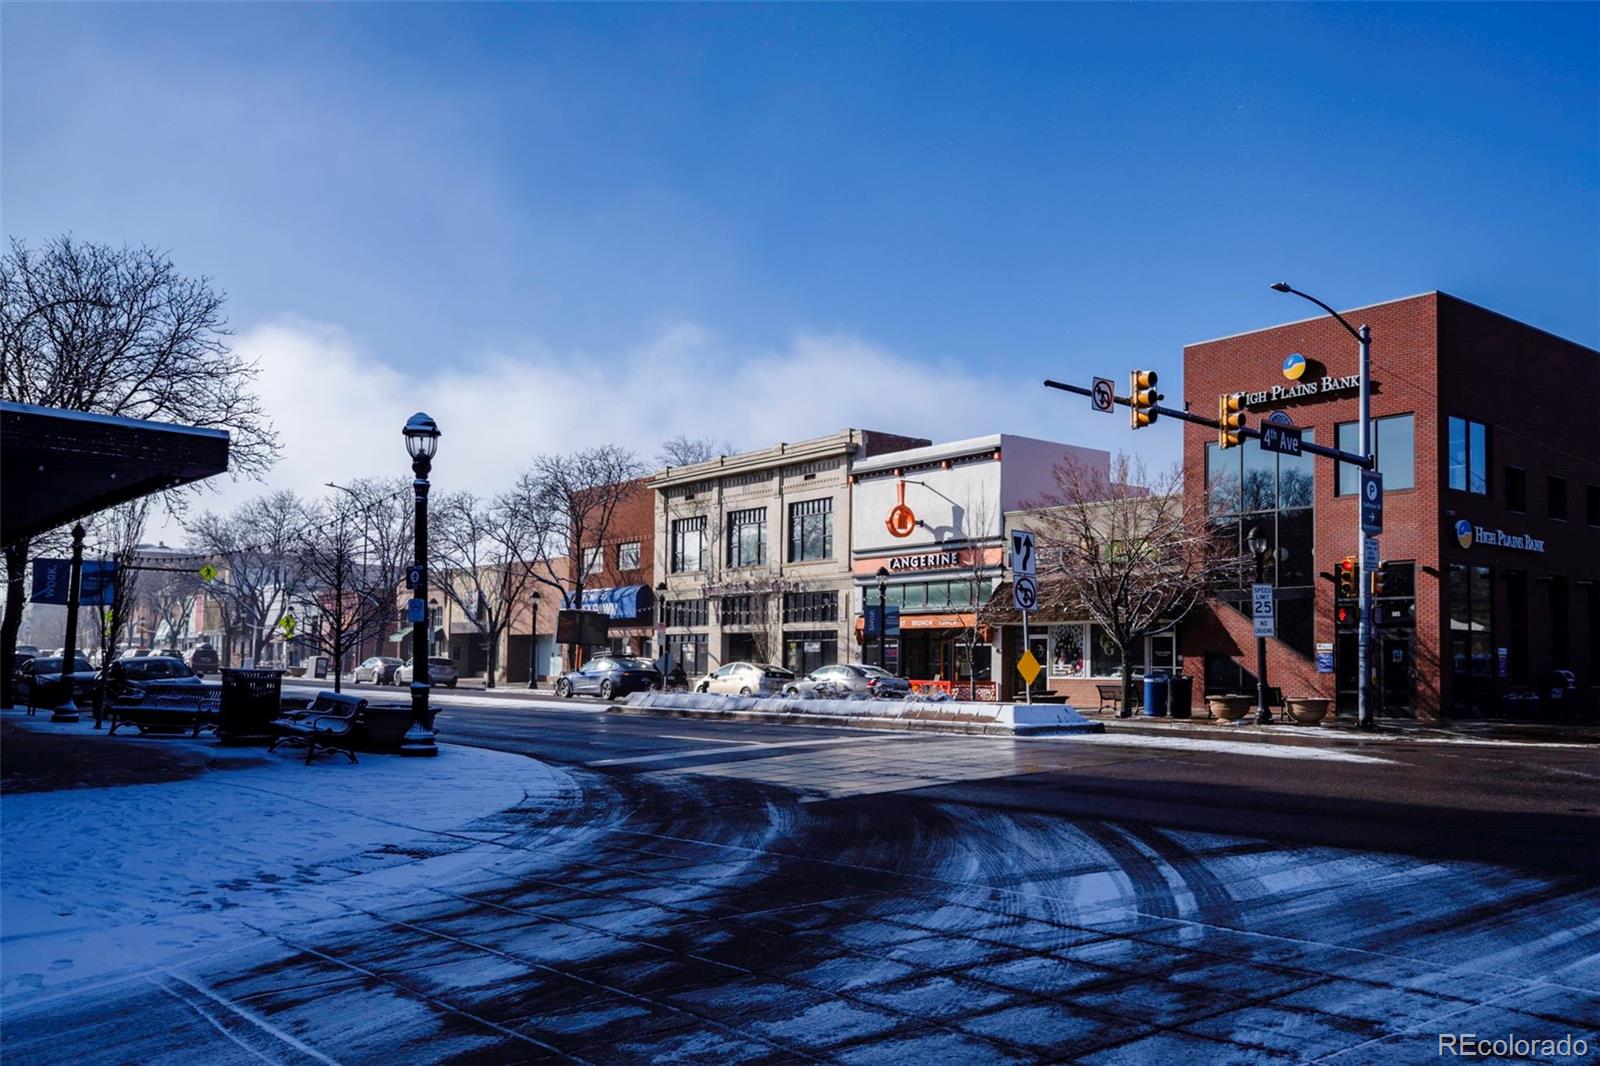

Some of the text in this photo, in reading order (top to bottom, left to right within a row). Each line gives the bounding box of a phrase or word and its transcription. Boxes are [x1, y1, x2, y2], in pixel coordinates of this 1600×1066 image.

[1264, 429, 1299, 451] 4th Ave
[888, 552, 957, 569] TANGERINE
[1255, 601, 1271, 613] 25
